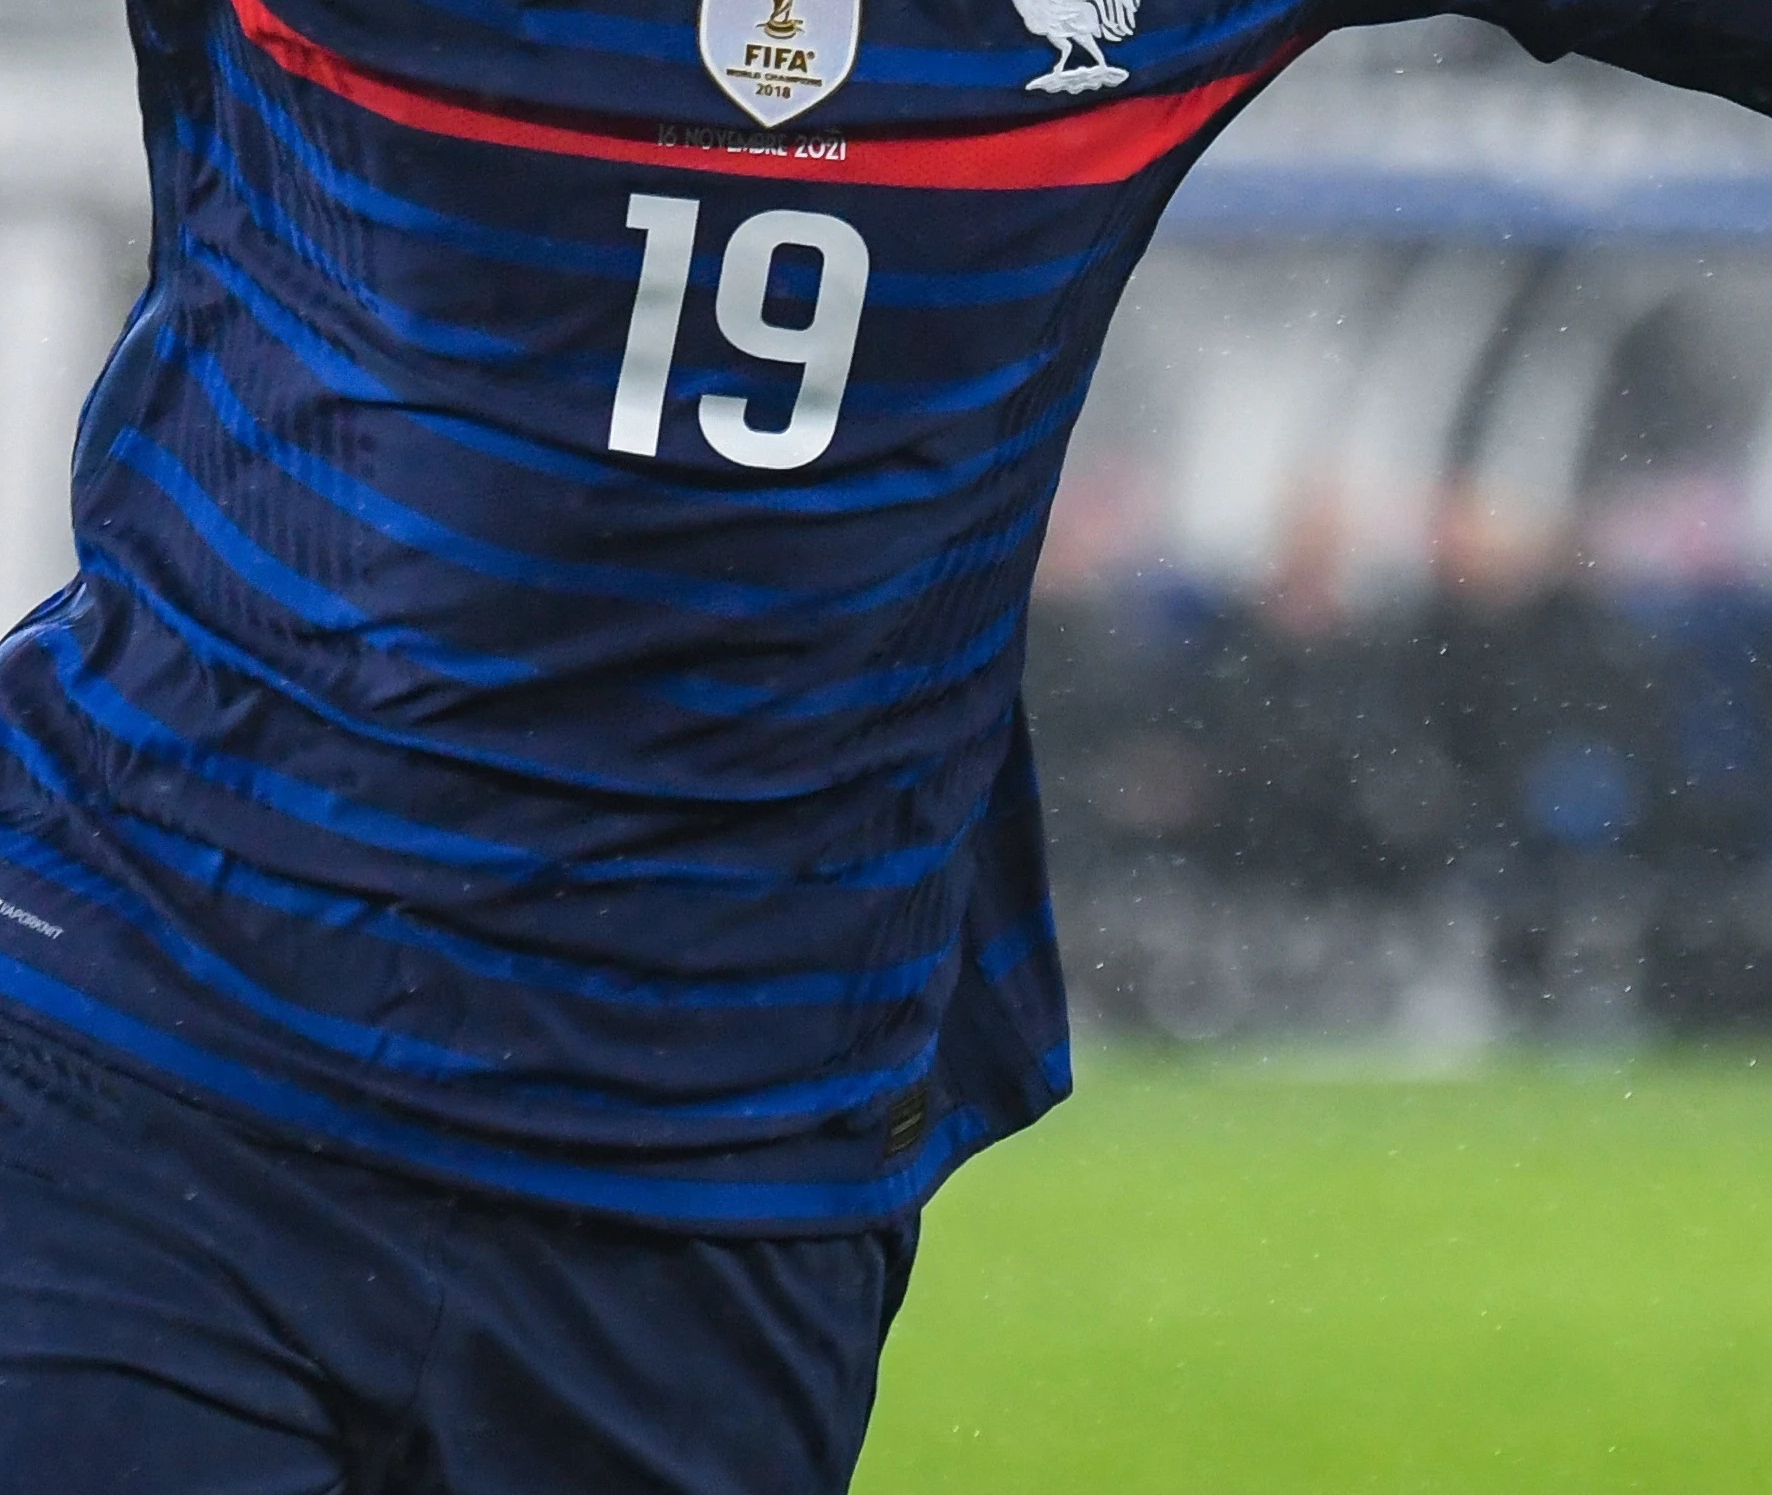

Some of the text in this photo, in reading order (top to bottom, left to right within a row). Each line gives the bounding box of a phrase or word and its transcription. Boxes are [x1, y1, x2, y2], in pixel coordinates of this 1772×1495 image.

[744, 44, 809, 73] FIFA
[755, 82, 792, 100] 2018
[793, 134, 847, 161] 2021
[608, 193, 870, 470] 19
